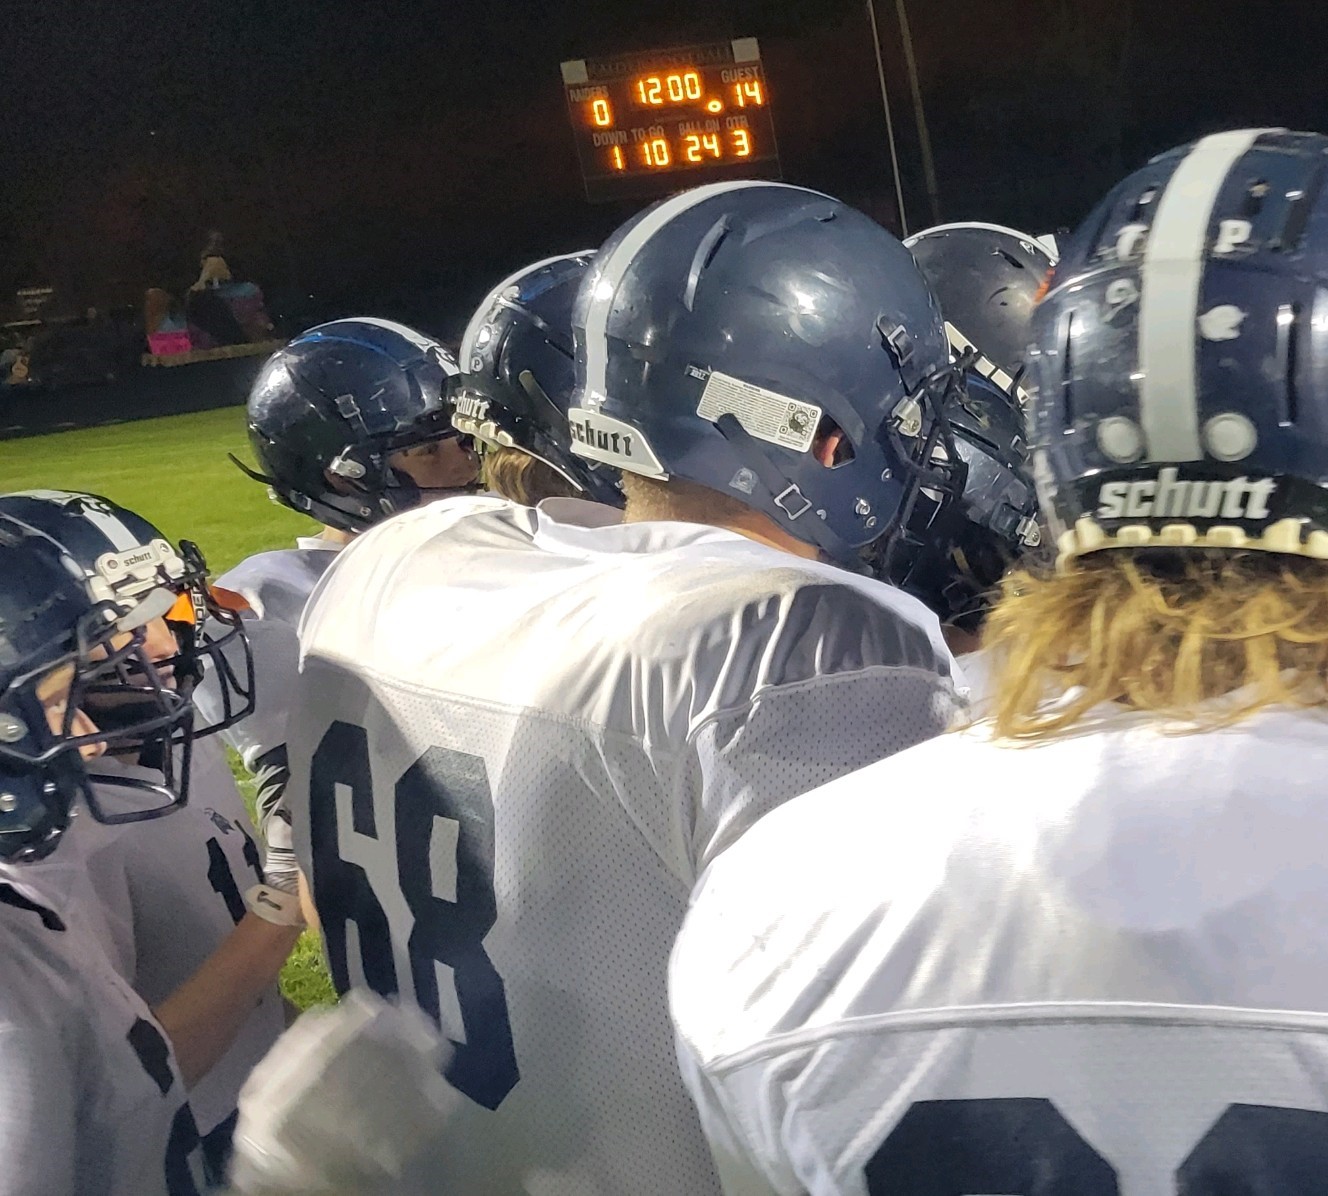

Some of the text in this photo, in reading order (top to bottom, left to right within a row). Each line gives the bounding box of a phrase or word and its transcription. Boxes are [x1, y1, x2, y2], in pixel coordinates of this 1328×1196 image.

[721, 66, 759, 83] GUEST
[735, 80, 762, 107] 14
[592, 99, 610, 126] 0
[593, 125, 665, 147] DOWN TO GO
[678, 121, 703, 137] BALL
[705, 117, 720, 132] ON
[643, 138, 670, 166] 10
[686, 133, 720, 162] 24
[732, 129, 750, 157] 3
[613, 144, 623, 170] 1
[1098, 466, 1278, 519] schutt
[123, 551, 153, 567] schutt
[309, 719, 521, 1111] 68
